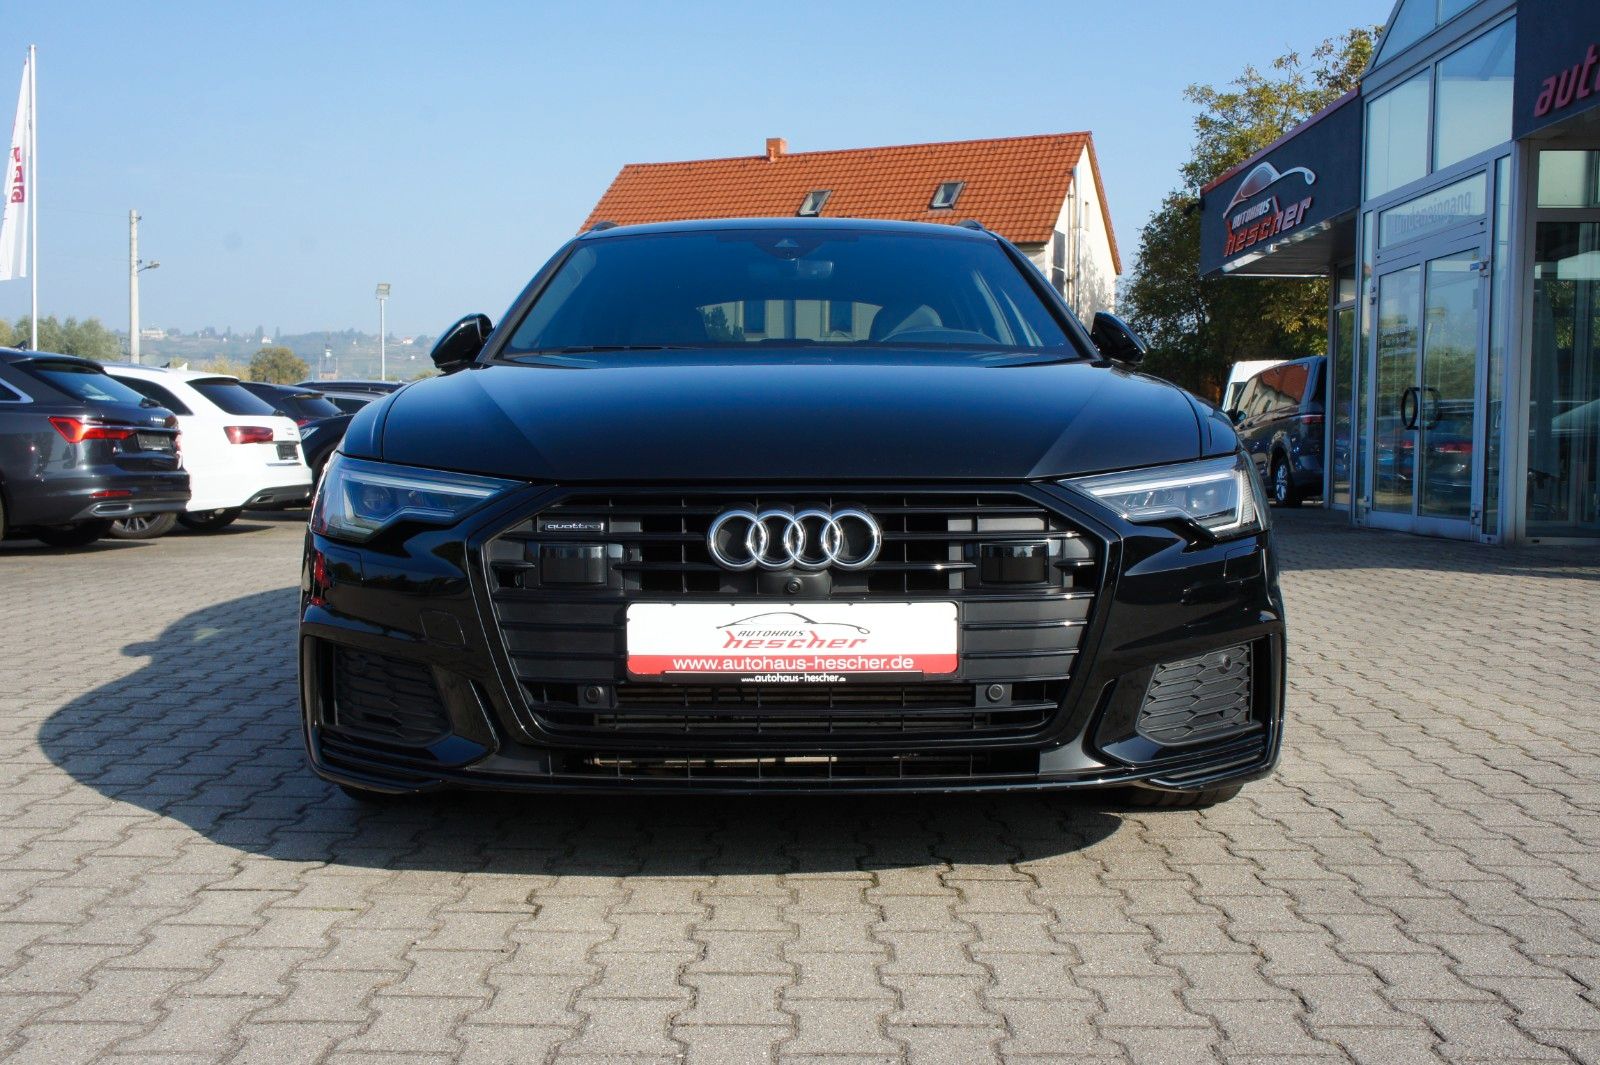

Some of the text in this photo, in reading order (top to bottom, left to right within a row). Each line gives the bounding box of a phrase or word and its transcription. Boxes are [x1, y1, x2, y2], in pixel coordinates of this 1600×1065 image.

[1533, 43, 1600, 118] aut
[1231, 198, 1272, 230] AUTOHAUS
[1223, 196, 1312, 257] hescher
[547, 521, 601, 530] quattro
[722, 630, 867, 648] hescher
[673, 656, 914, 671] www.autohaus-hescher.de
[741, 673, 846, 683] www.autohaus-hescher.de
